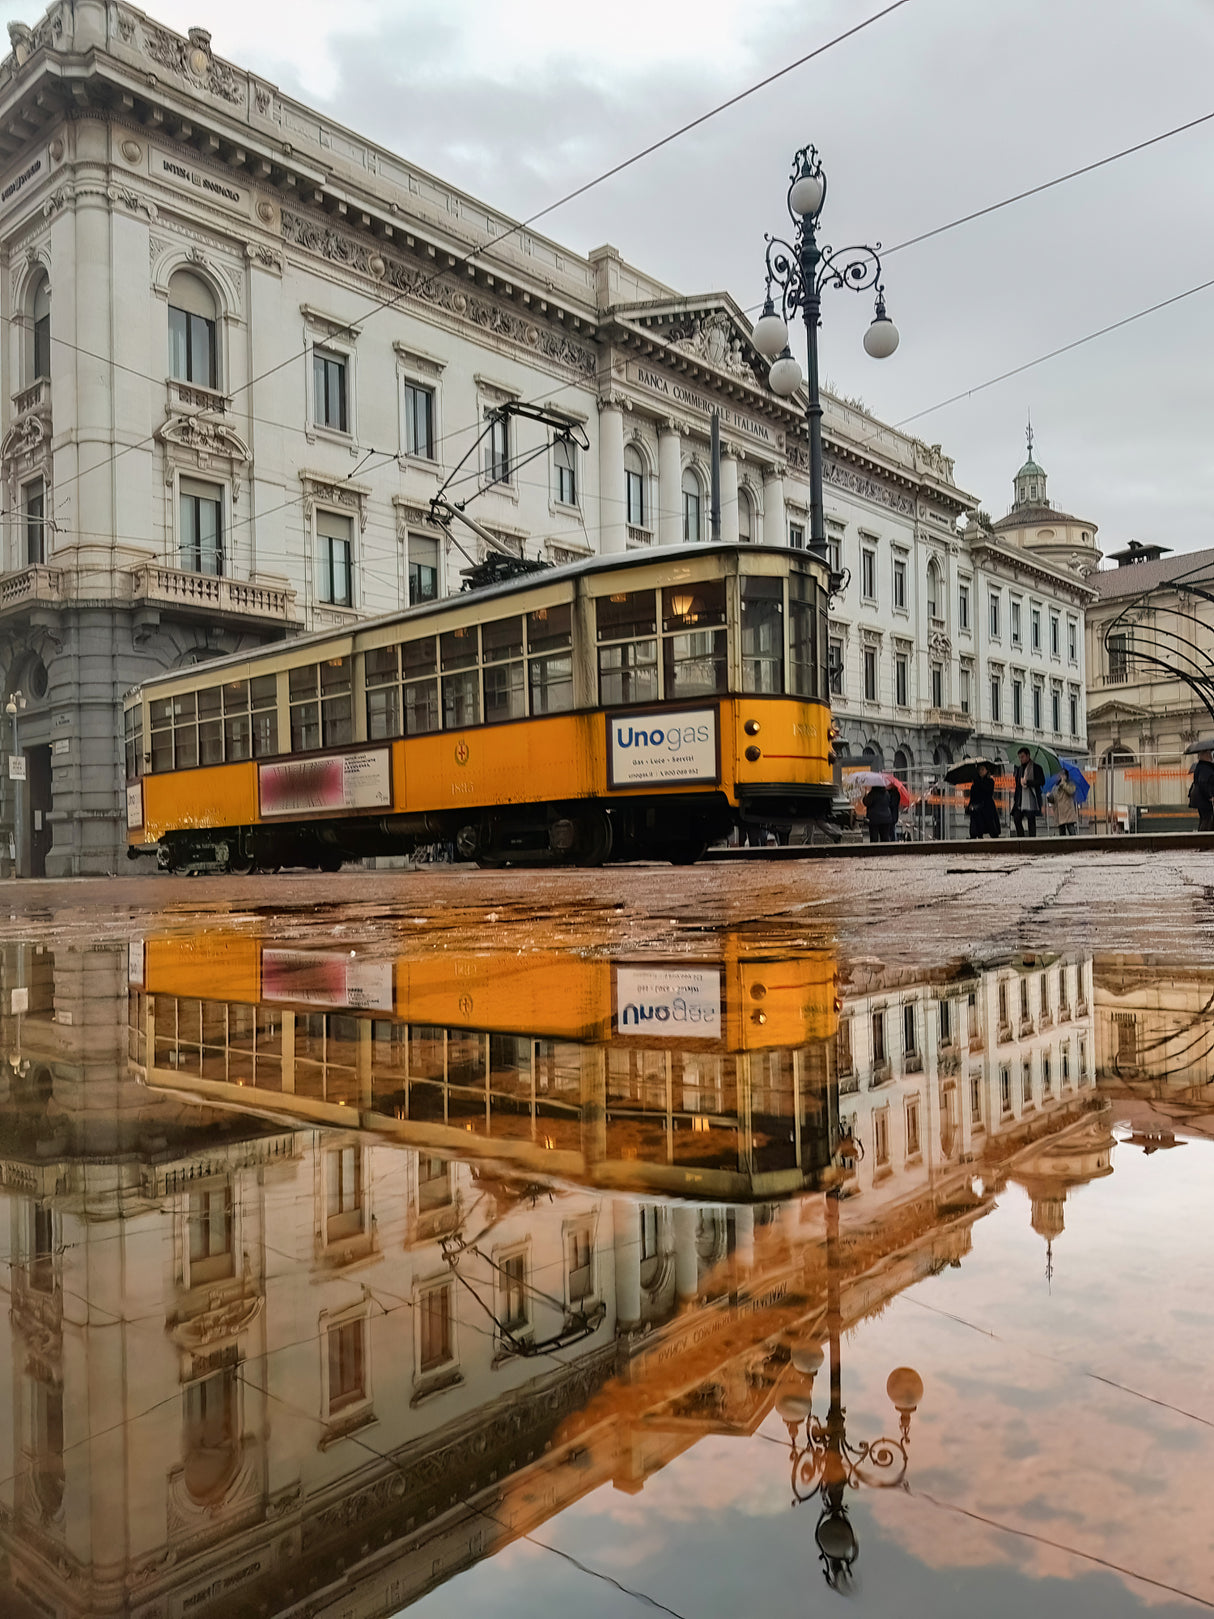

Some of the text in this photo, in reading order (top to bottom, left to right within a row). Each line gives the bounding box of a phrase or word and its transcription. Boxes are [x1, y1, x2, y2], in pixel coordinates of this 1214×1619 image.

[638, 368, 769, 440] BANCA COMMERCIALE ITALIANA
[617, 725, 709, 752] Unogas
